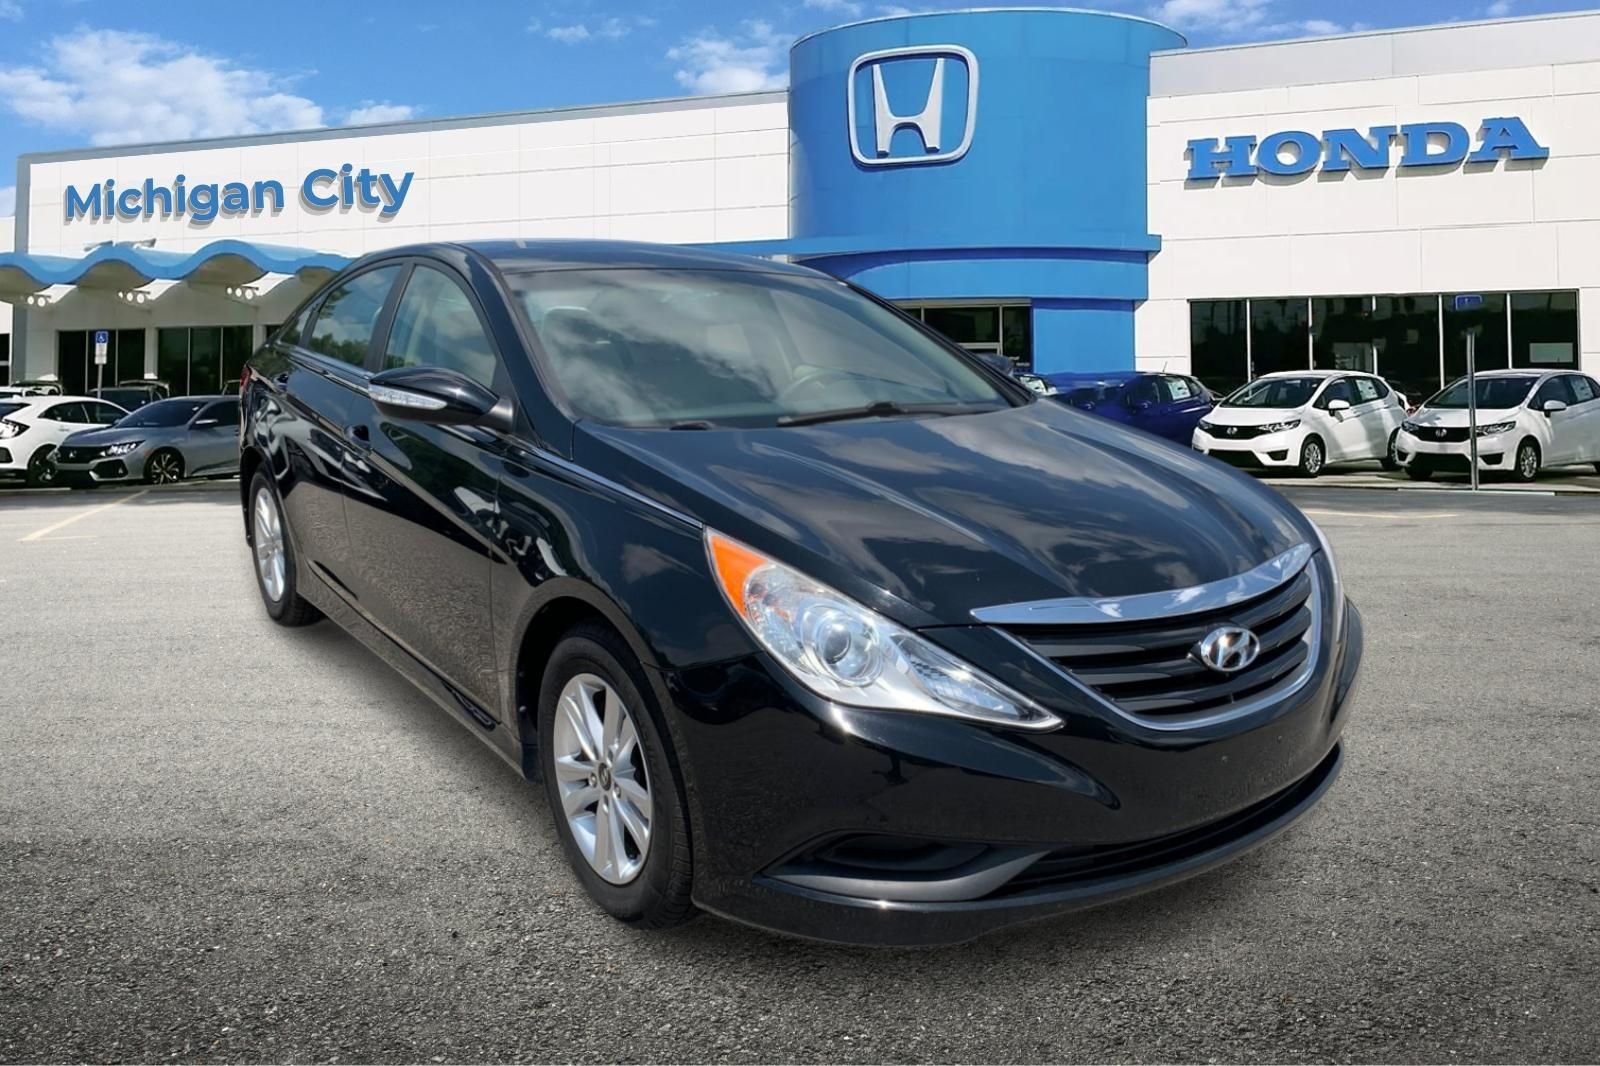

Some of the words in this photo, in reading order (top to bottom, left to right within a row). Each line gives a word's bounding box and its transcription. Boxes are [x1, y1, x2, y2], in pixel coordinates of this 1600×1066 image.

[1184, 116, 1550, 182] HONDA
[65, 173, 284, 222] Michigan
[303, 163, 414, 214] City
